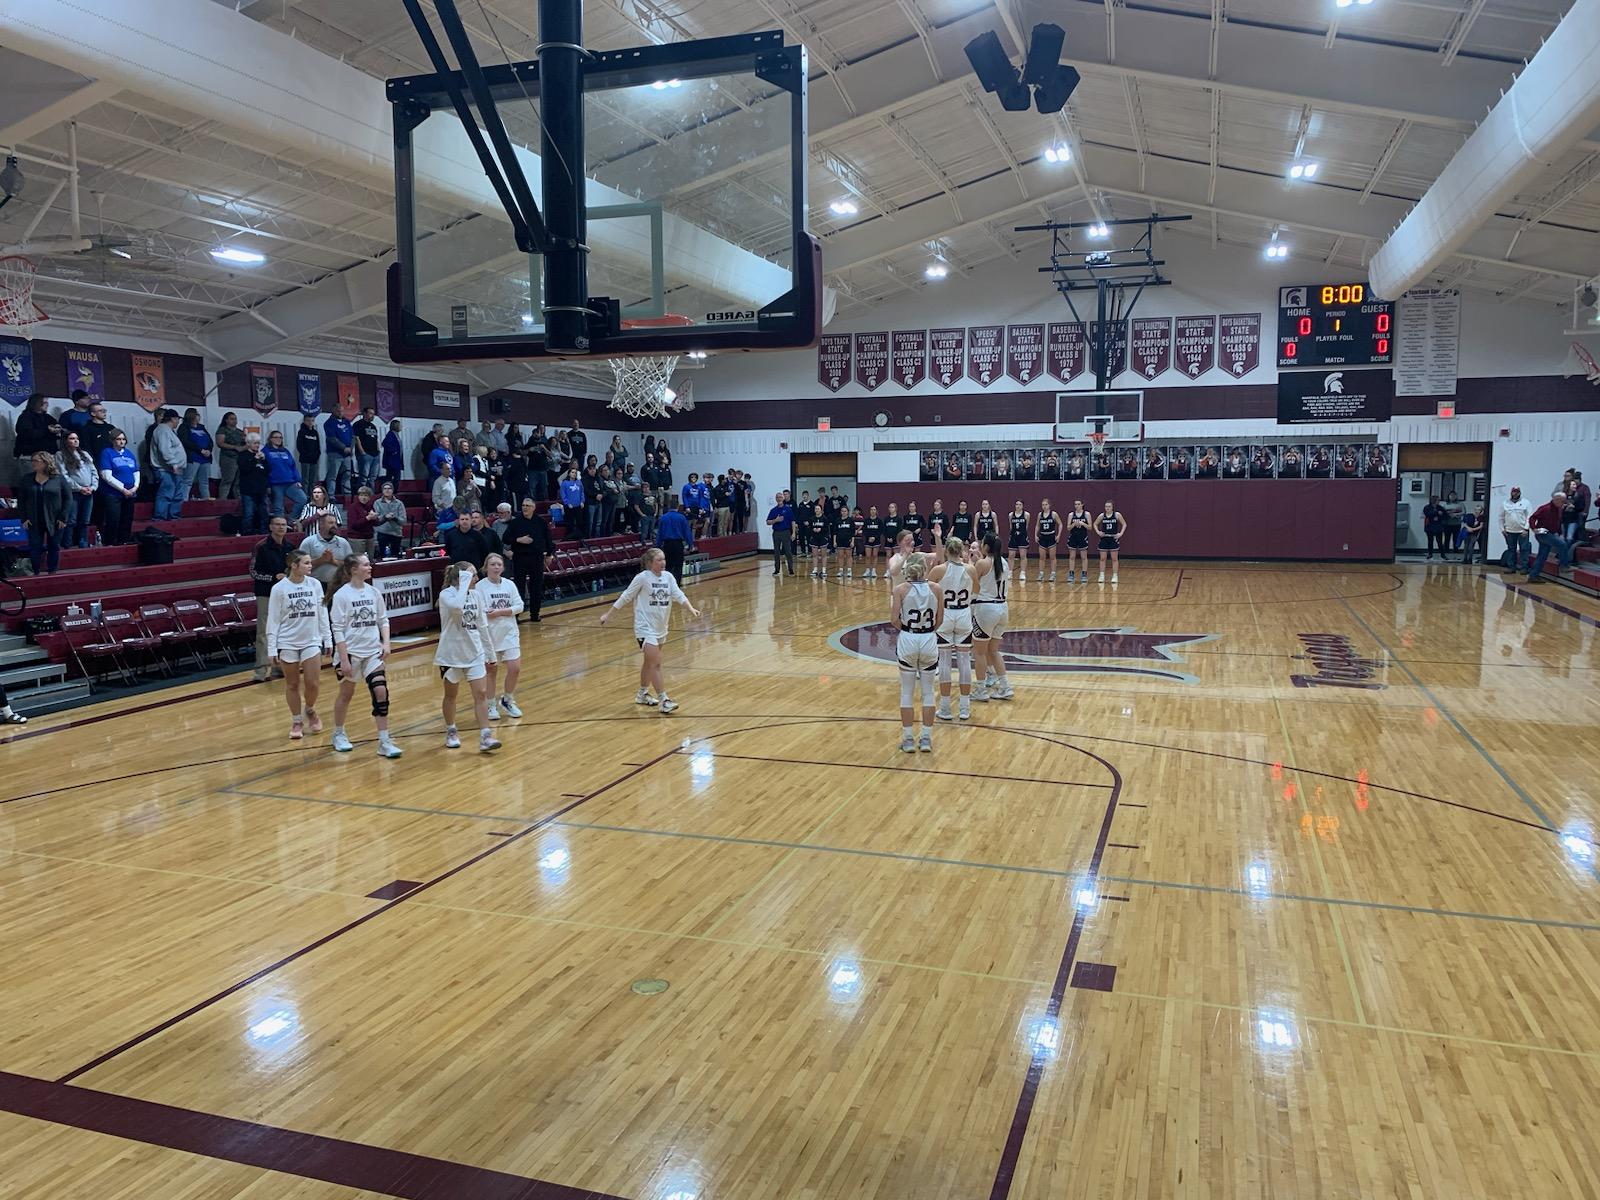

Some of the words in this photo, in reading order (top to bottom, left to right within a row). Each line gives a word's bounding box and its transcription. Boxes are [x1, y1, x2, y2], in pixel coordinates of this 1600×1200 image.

[1322, 285, 1363, 304] 8:00
[1287, 308, 1311, 317] HOME
[1361, 304, 1389, 313] GUEST
[1300, 317, 1312, 335] 0
[1335, 319, 1340, 332] 1
[1377, 314, 1389, 332] 0
[976, 330, 997, 338] SPEECH
[1012, 327, 1041, 337] BASEBALL
[1052, 325, 1082, 335] BASEBALL
[1142, 330, 1161, 338] STATE
[1185, 328, 1205, 336] STATE
[1230, 326, 1249, 335] STATE
[834, 337, 849, 345] TRACK
[858, 335, 885, 344] FOOTBALL
[895, 333, 923, 342] FOOTBALL
[978, 338, 995, 346] STATE
[1017, 336, 1034, 344] STATE
[1058, 334, 1076, 343] STATE
[1177, 336, 1213, 346] CHAMPIONS
[1221, 335, 1257, 344] CHAMPIONS
[901, 342, 917, 350] STATE
[939, 340, 956, 348] STATE
[1050, 342, 1084, 351] RUNNER-UP
[1133, 338, 1170, 347] CHAMPIONS
[1377, 339, 1388, 353] 0
[828, 345, 843, 353] STATE
[864, 343, 880, 352] STATE
[971, 346, 1001, 355] RUNNER-UP
[1009, 344, 1042, 353] CHAMPIONS
[1138, 347, 1158, 355] CLASS
[1181, 345, 1201, 354] CLASS
[1226, 344, 1246, 352] CLASS
[1286, 343, 1296, 357] 0
[68, 350, 99, 362] WAUSA
[820, 353, 850, 361] RUNNER-UP
[857, 351, 887, 360] CHAMPIONS
[894, 350, 925, 358] CHAMPIONS
[1014, 353, 1032, 361] CLASS
[1054, 351, 1073, 359] CLASS
[134, 357, 161, 368] OSMOND
[896, 358, 913, 366] CLASS
[936, 356, 953, 365] CLASS
[973, 355, 990, 363] CLASS
[825, 361, 841, 369] CLASS
[860, 360, 876, 368] CLASS
[298, 373, 319, 381] WYNOT
[383, 580, 411, 590] Welcome
[996, 580, 1006, 599] 11
[288, 591, 313, 600] WAKEFIELD
[382, 587, 431, 611] AKEFIELD
[944, 589, 969, 609] 22
[351, 600, 374, 608] WAKEFIELD
[907, 608, 934, 631] 23
